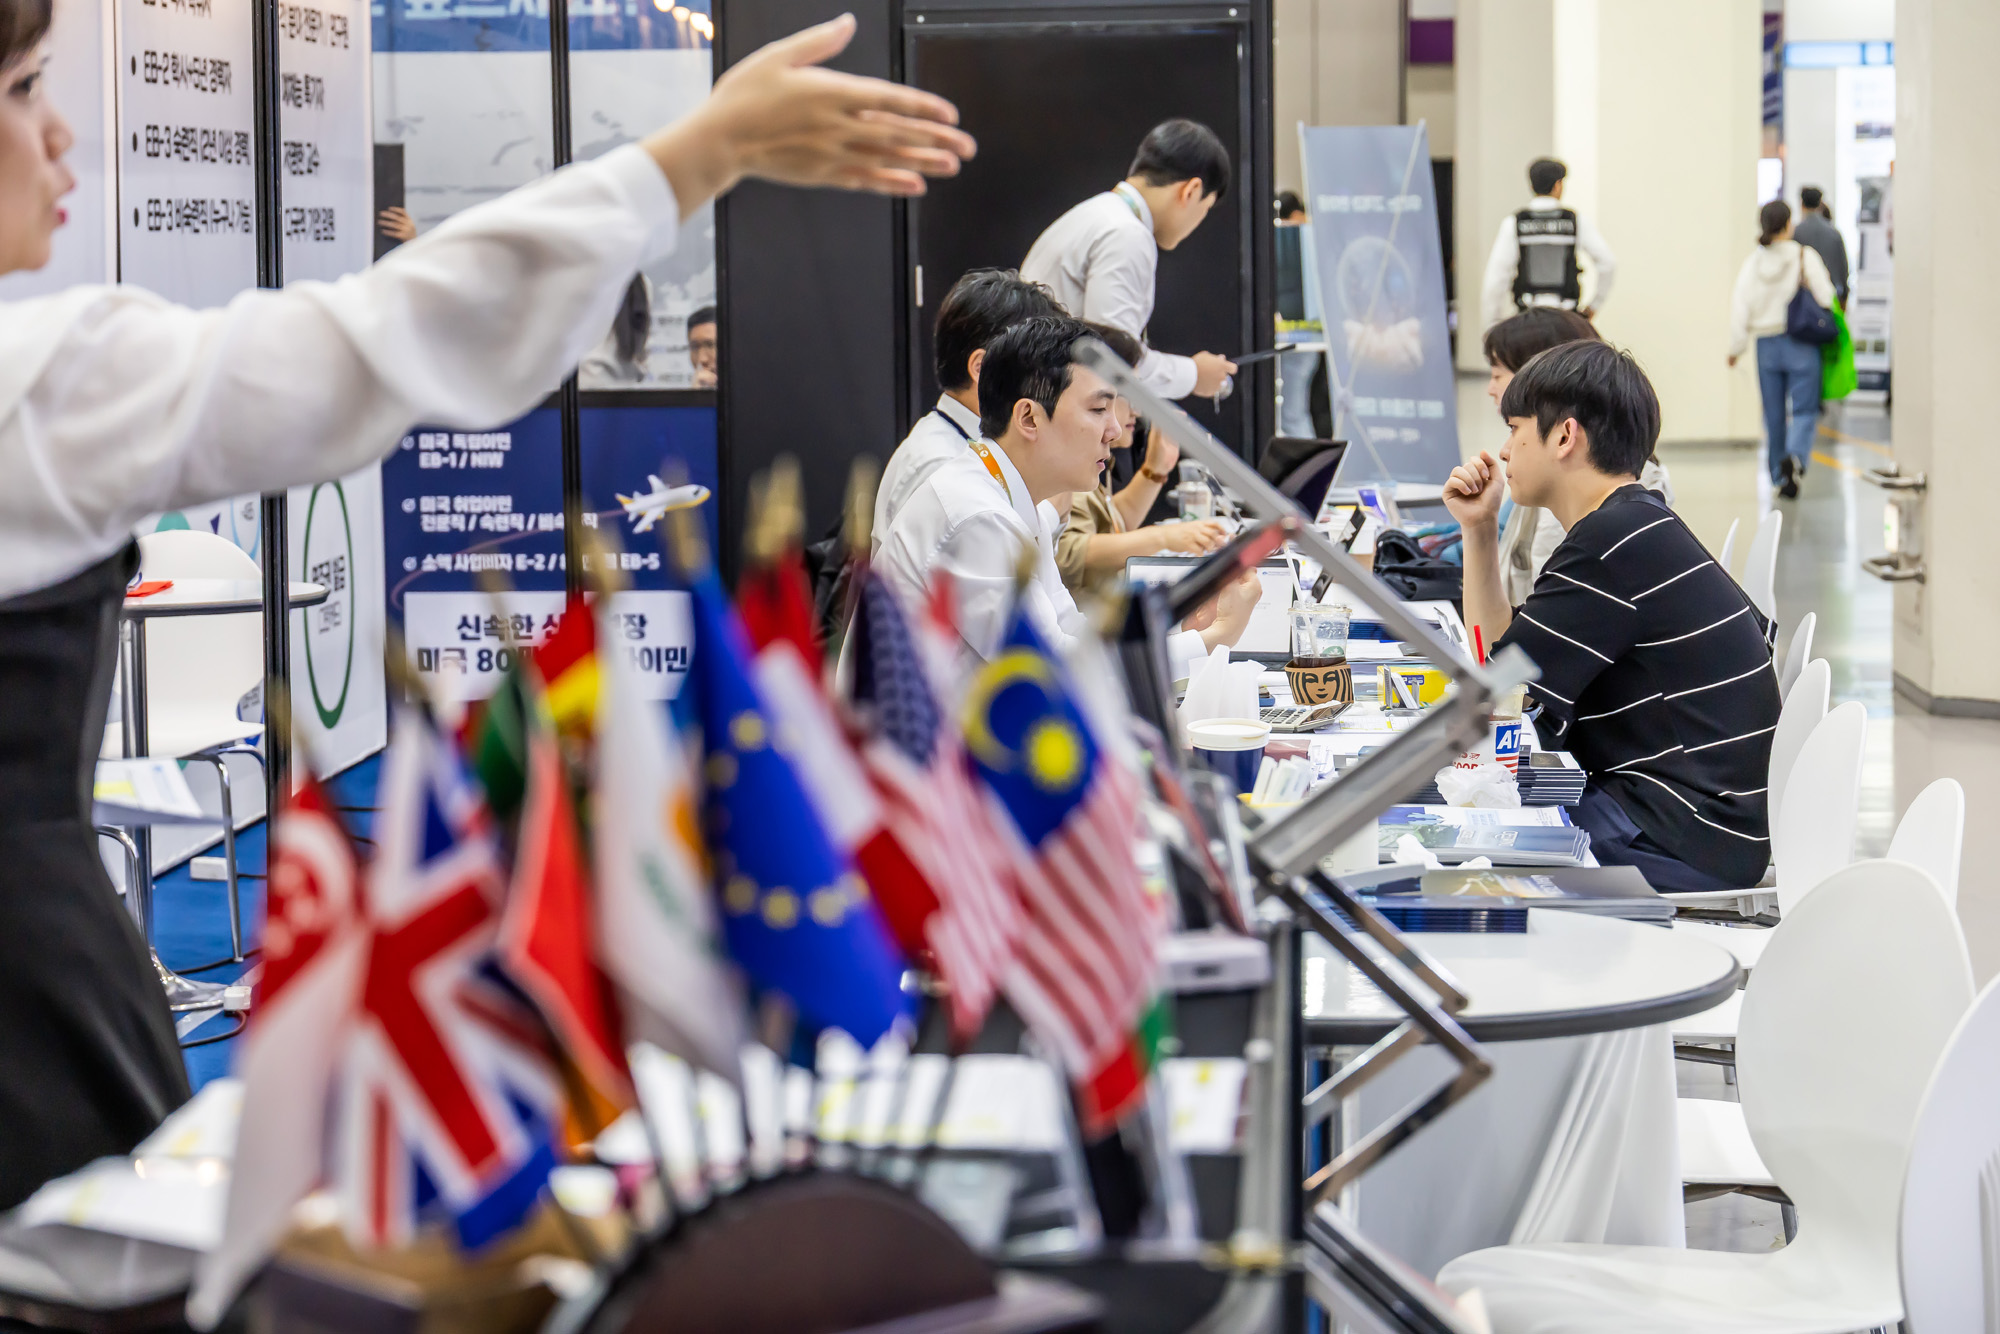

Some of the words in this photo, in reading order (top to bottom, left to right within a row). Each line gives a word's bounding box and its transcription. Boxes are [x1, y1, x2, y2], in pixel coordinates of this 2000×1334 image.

[144, 50, 170, 85] EB-2
[146, 124, 171, 158] EB-3
[147, 198, 173, 231] EB-3
[418, 432, 450, 451] 미국
[419, 451, 458, 469] EB-1
[419, 495, 451, 515] 미국
[515, 553, 546, 571] E-2
[457, 613, 534, 641] 신속한
[417, 647, 467, 674] 미국
